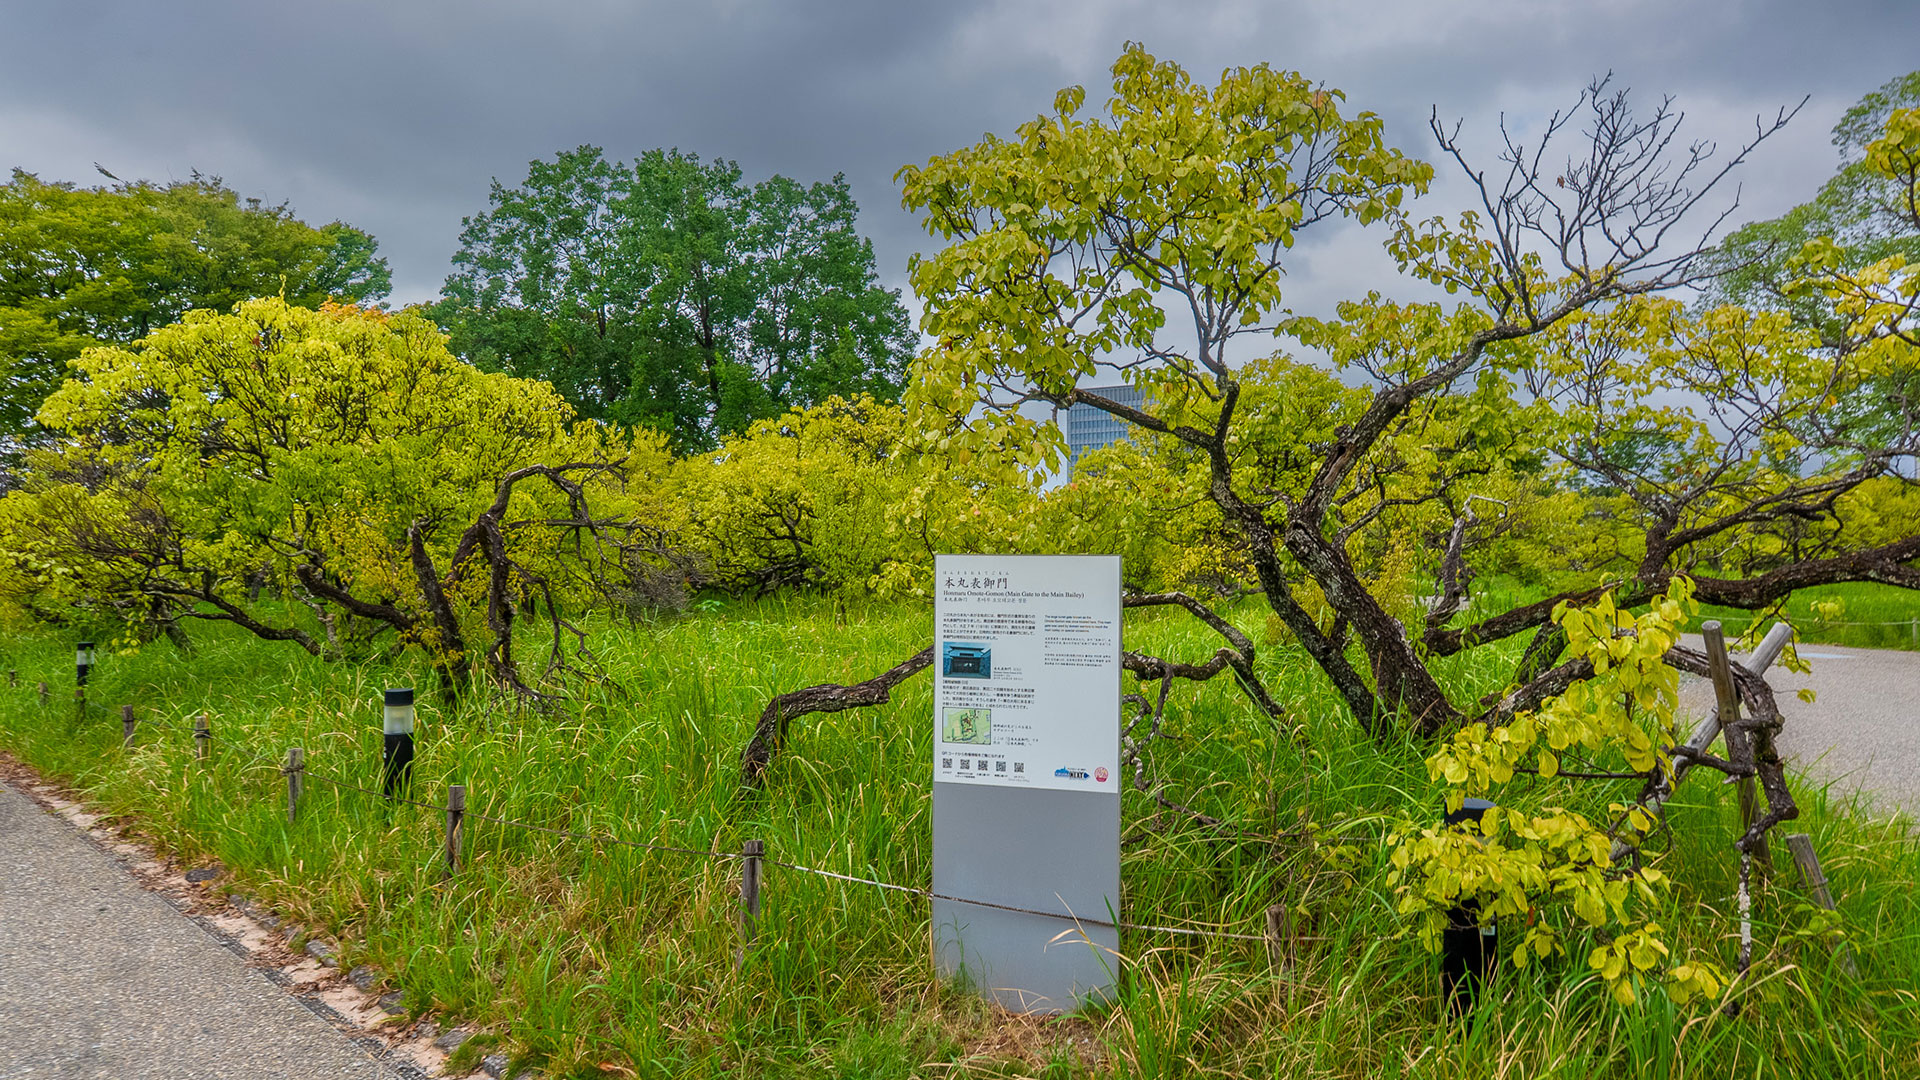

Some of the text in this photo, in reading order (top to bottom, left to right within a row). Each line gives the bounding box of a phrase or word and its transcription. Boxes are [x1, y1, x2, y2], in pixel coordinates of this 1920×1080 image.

[944, 576, 1008, 589] 本丸表御門
